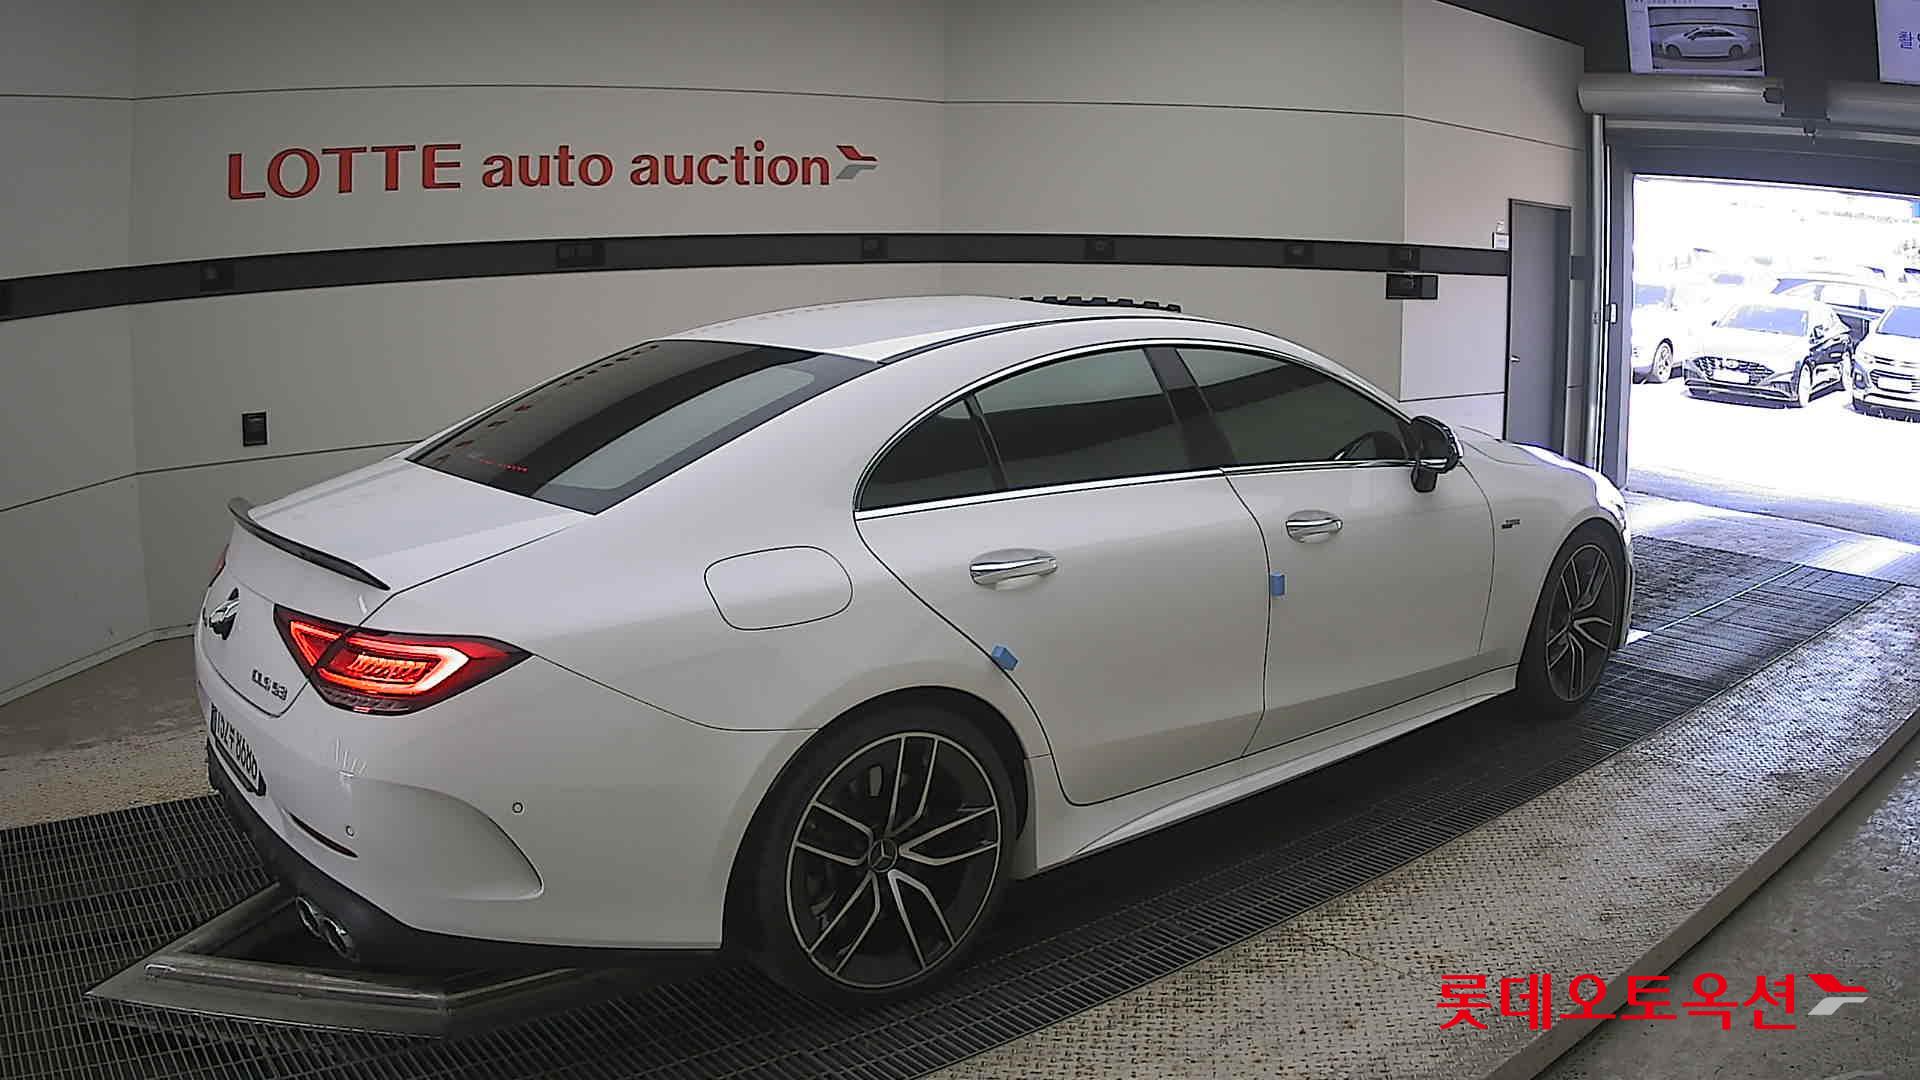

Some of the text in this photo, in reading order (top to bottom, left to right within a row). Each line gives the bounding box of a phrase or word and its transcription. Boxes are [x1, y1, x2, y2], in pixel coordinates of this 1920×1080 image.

[228, 140, 830, 200] LOTTE auto auction
[252, 669, 288, 701] CLS 53
